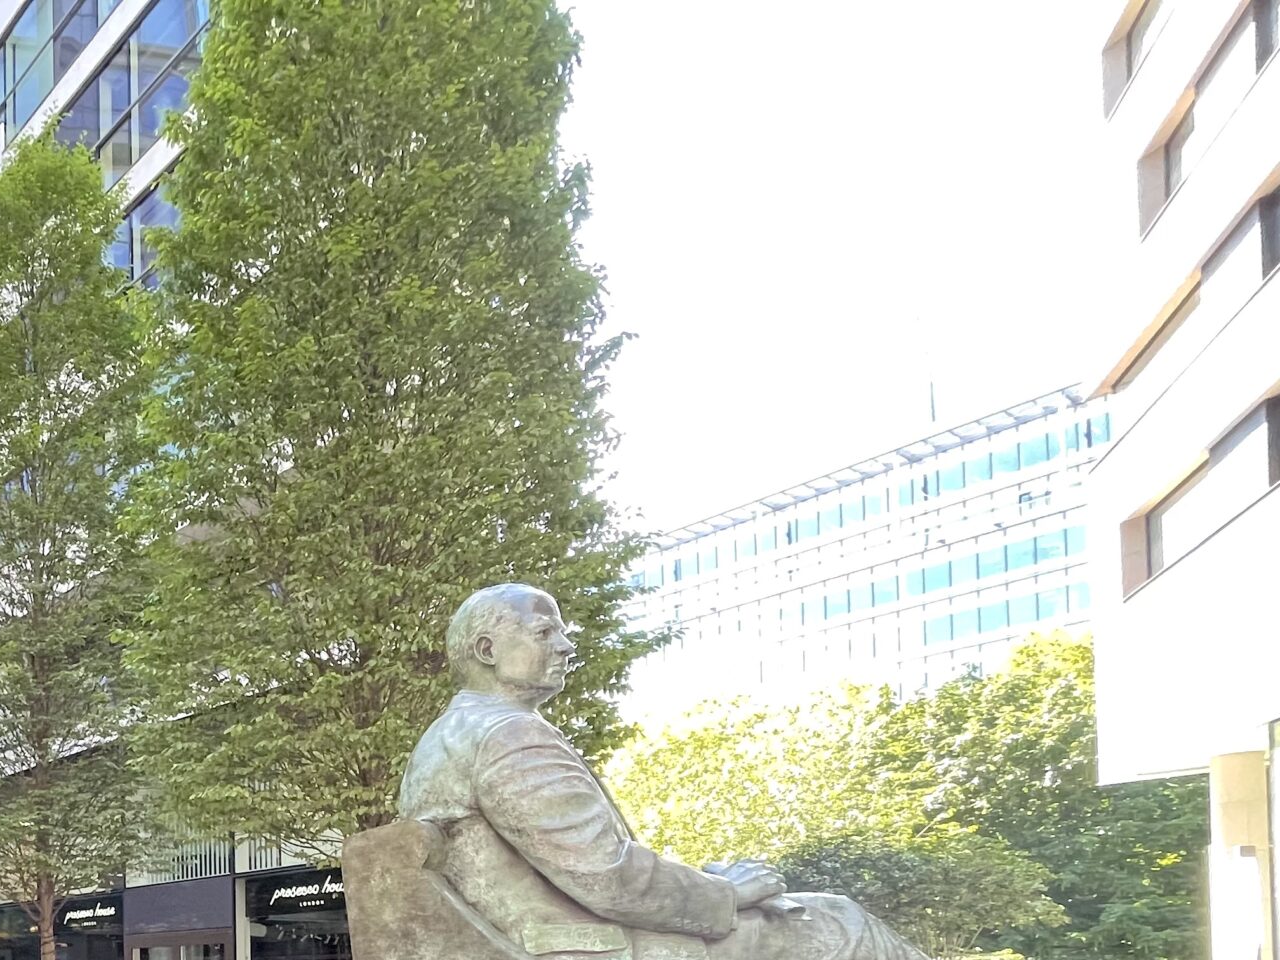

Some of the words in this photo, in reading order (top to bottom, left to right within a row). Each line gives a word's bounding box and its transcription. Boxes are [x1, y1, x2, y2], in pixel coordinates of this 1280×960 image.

[269, 884, 319, 905] prosecco
[321, 875, 344, 893] hou
[63, 909, 94, 925] prosecco
[94, 902, 116, 916] house
